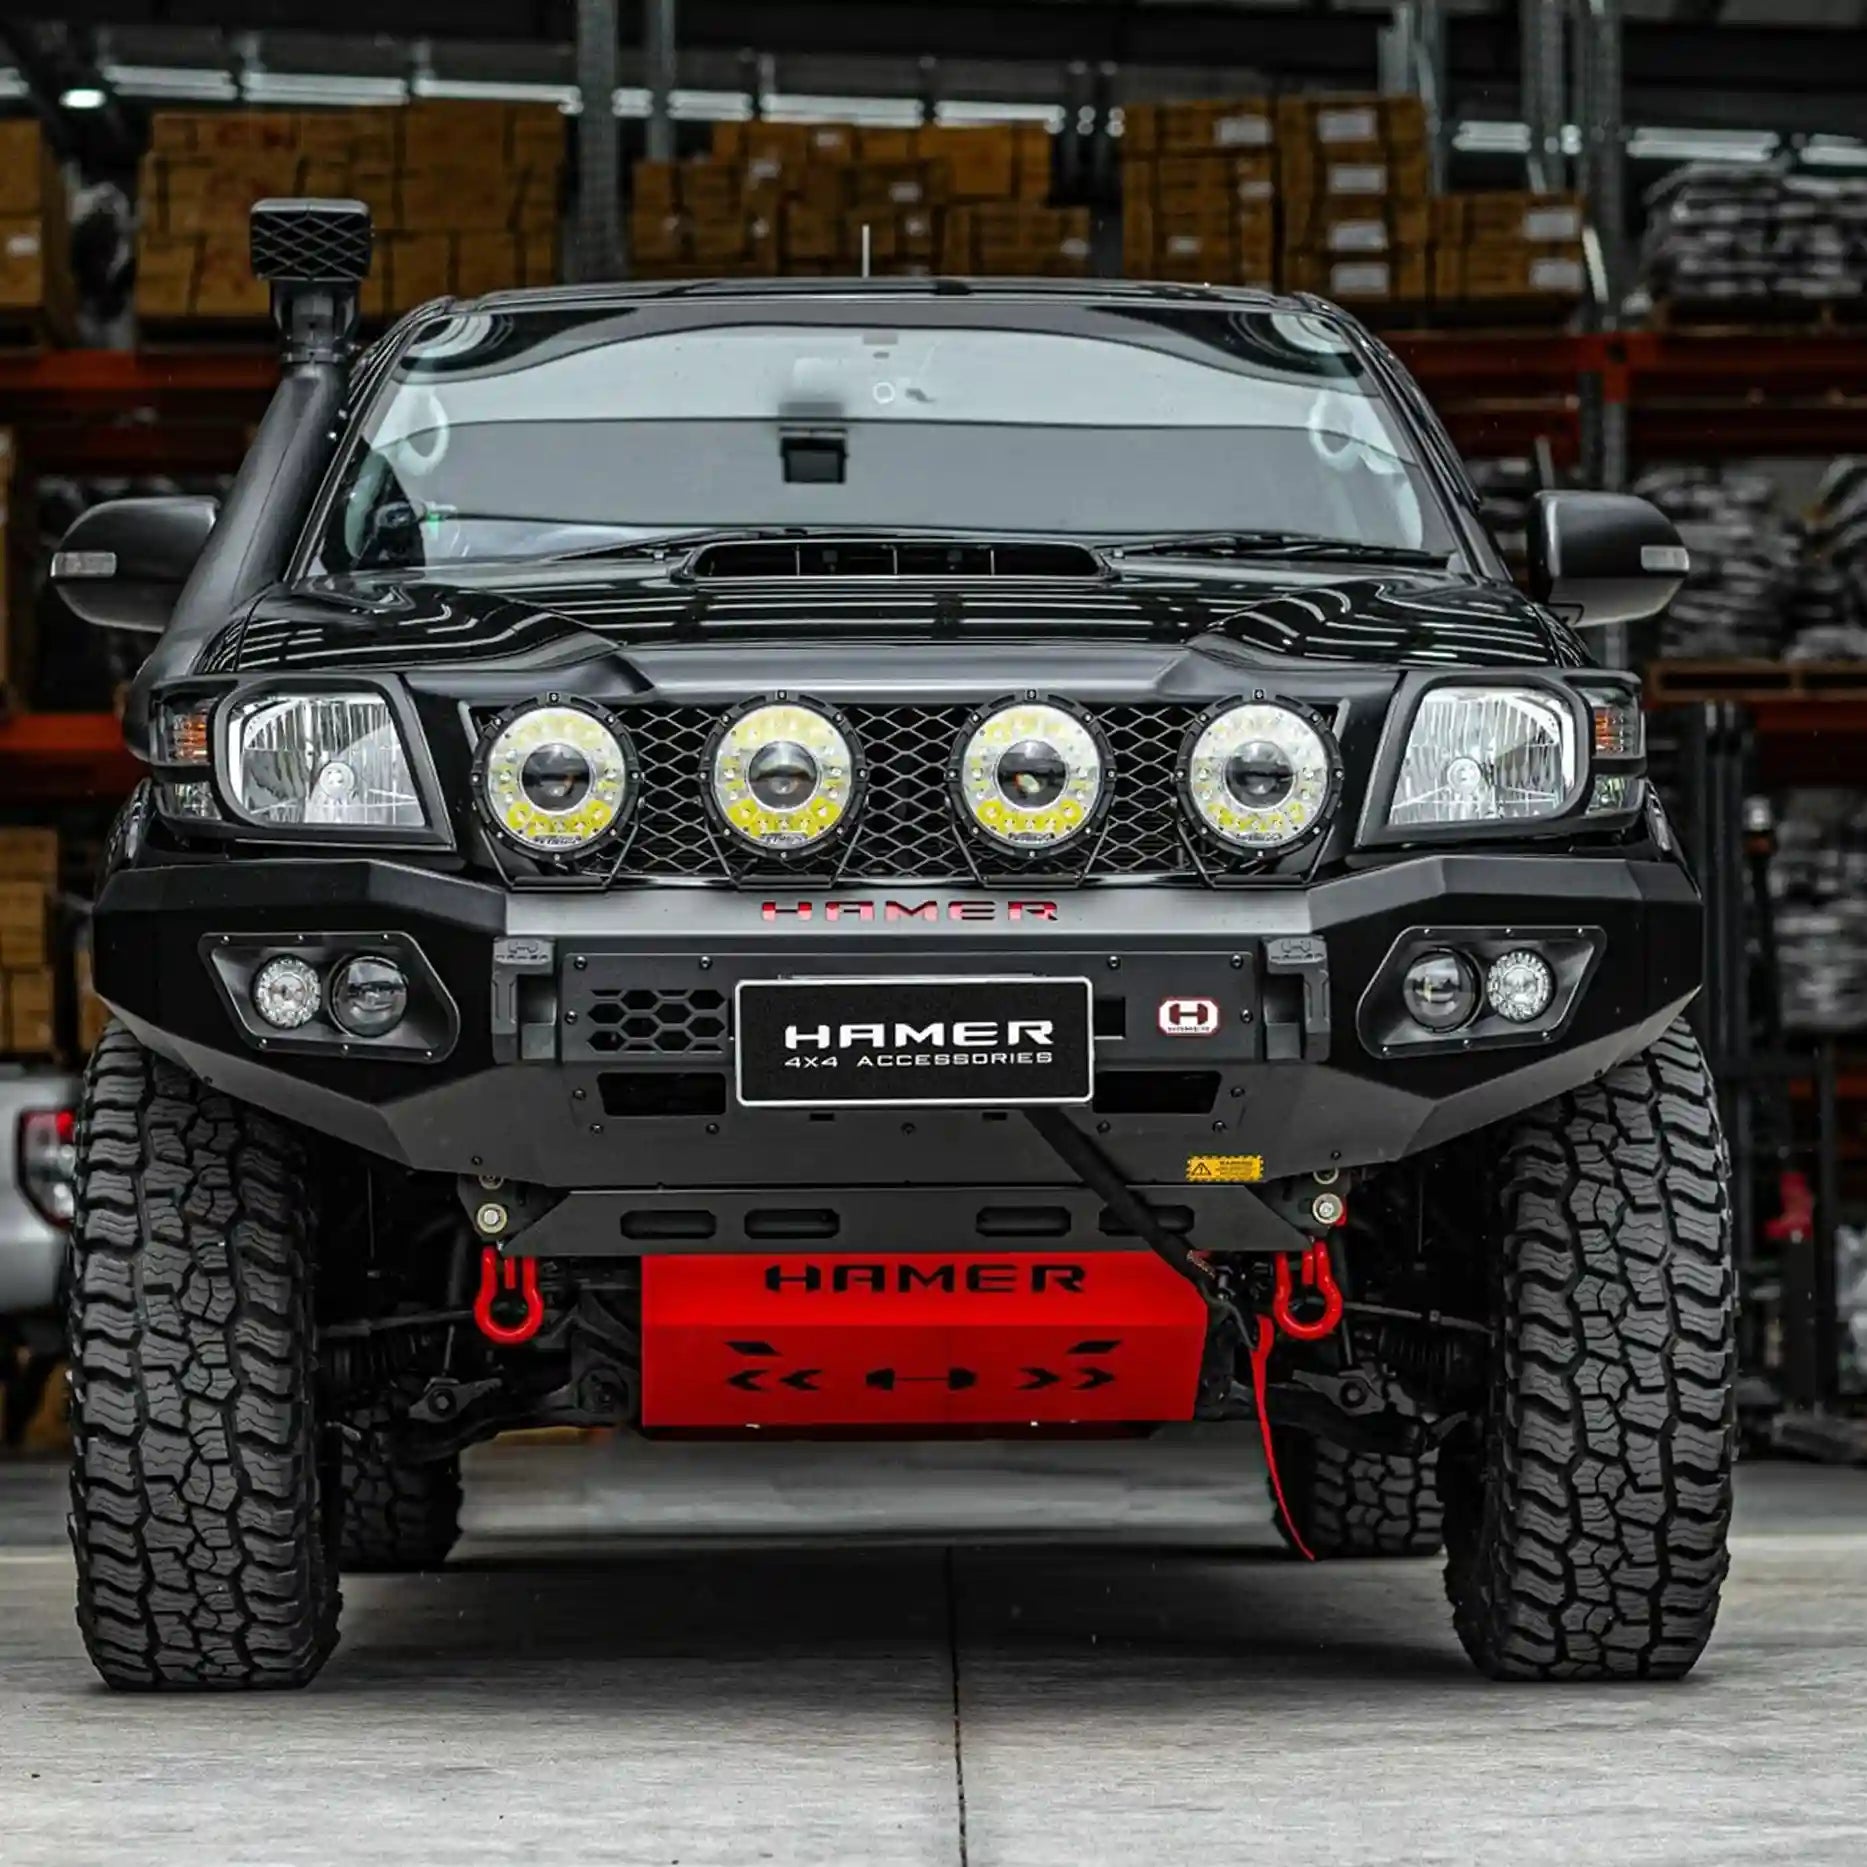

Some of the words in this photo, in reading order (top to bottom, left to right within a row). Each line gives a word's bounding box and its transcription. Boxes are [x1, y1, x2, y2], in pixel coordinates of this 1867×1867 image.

[761, 901, 1058, 921] HAMER
[784, 1020, 1054, 1050] HAMER
[857, 1052, 1054, 1068] ACCESSORIES
[765, 1263, 1087, 1294] HAMER
